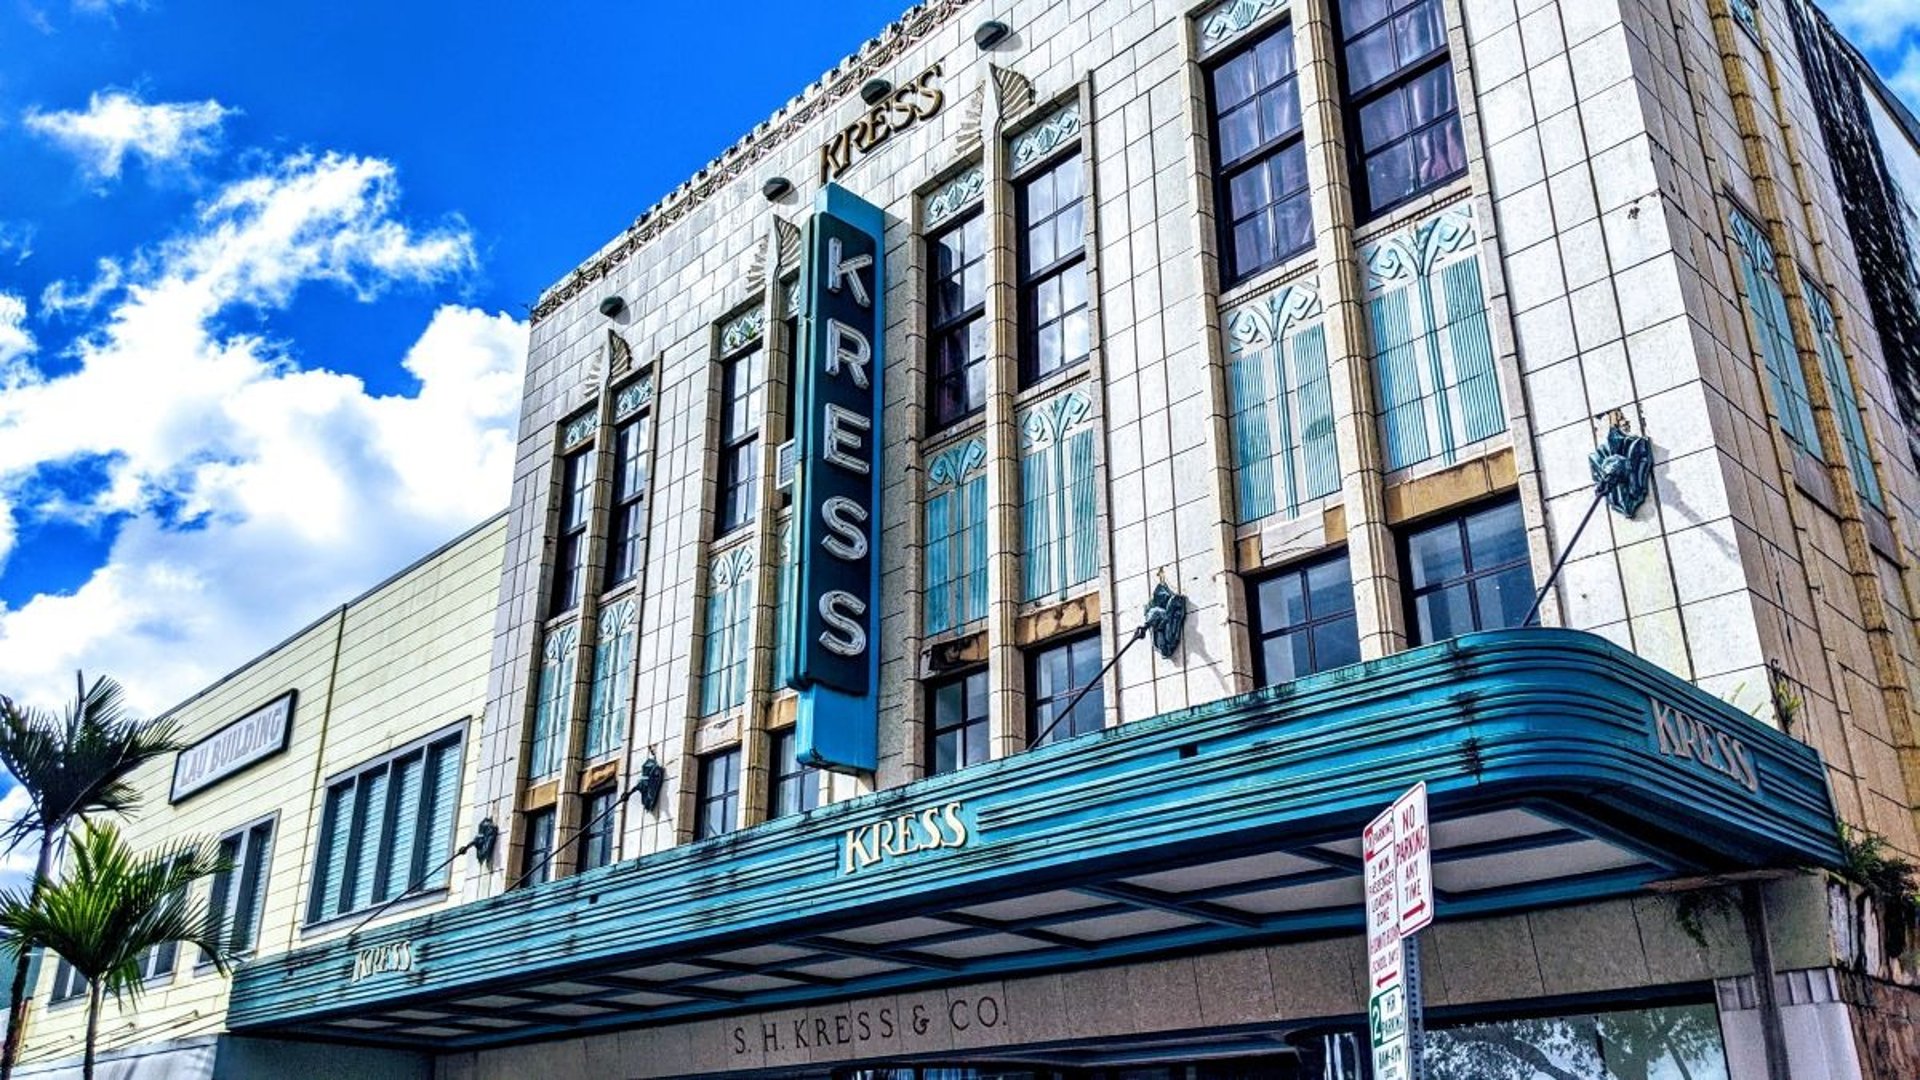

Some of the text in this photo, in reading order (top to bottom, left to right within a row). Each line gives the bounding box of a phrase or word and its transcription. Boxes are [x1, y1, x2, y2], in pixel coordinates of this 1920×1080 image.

[819, 64, 944, 185] KRESS
[818, 235, 875, 658] KRESS
[180, 706, 283, 788] LAU BUILDING
[1650, 696, 1759, 792] KRESS
[844, 801, 967, 876] KRESS
[1402, 804, 1415, 834] NO
[1378, 855, 1390, 873] MIN
[1396, 825, 1426, 864] PARKING
[1405, 860, 1419, 879] ANY
[1372, 887, 1394, 913] LOADING
[1404, 879, 1422, 903] TIME
[1376, 906, 1390, 927] ZONE
[352, 940, 411, 983] KRESS
[763, 1022, 786, 1052] H.
[794, 1008, 895, 1049] KRESS
[912, 1004, 931, 1036] &
[949, 996, 1008, 1032] CO.
[1372, 1004, 1381, 1042] 2
